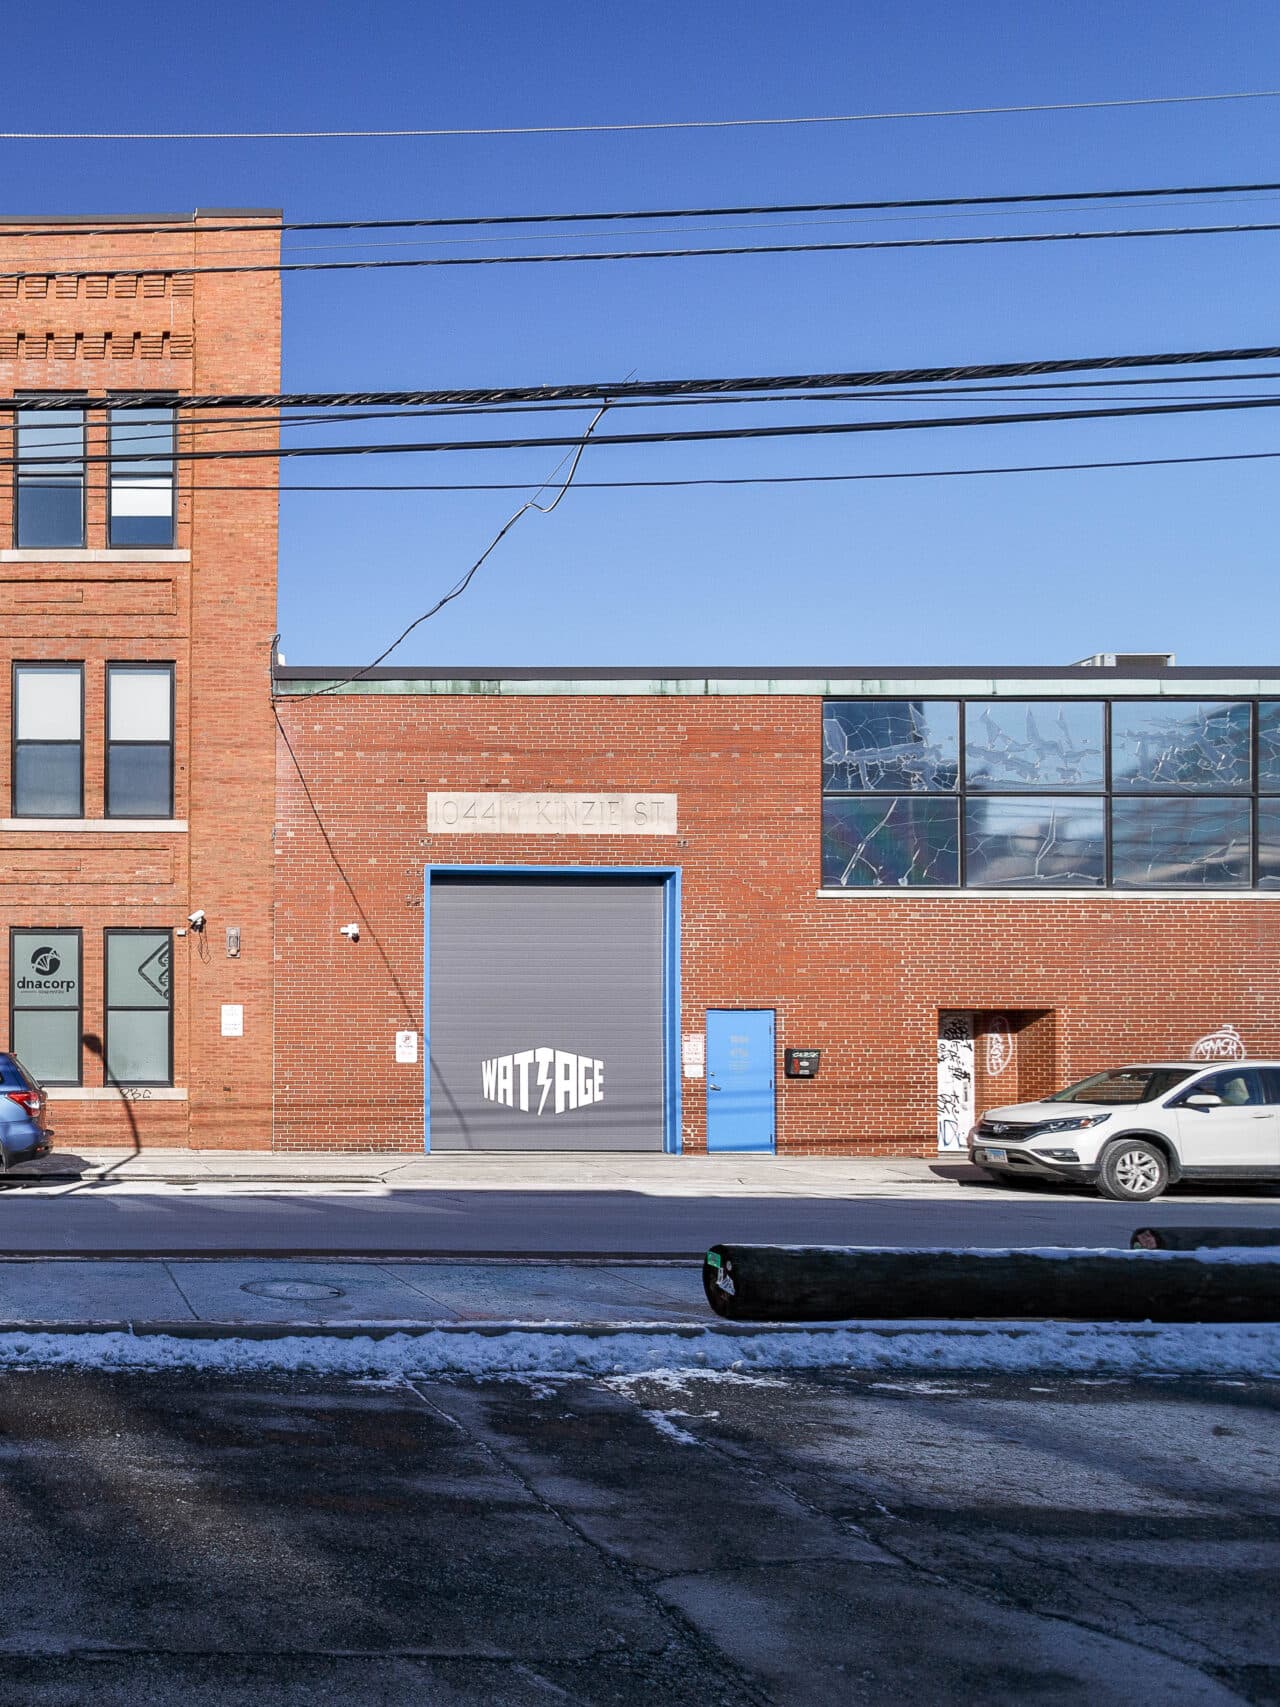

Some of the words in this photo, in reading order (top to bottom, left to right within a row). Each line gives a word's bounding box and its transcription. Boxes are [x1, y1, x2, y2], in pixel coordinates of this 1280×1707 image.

[432, 800, 498, 826] 1044
[535, 800, 621, 826] KINZIE
[633, 800, 666, 826] ST
[16, 976, 76, 993] dnacorp
